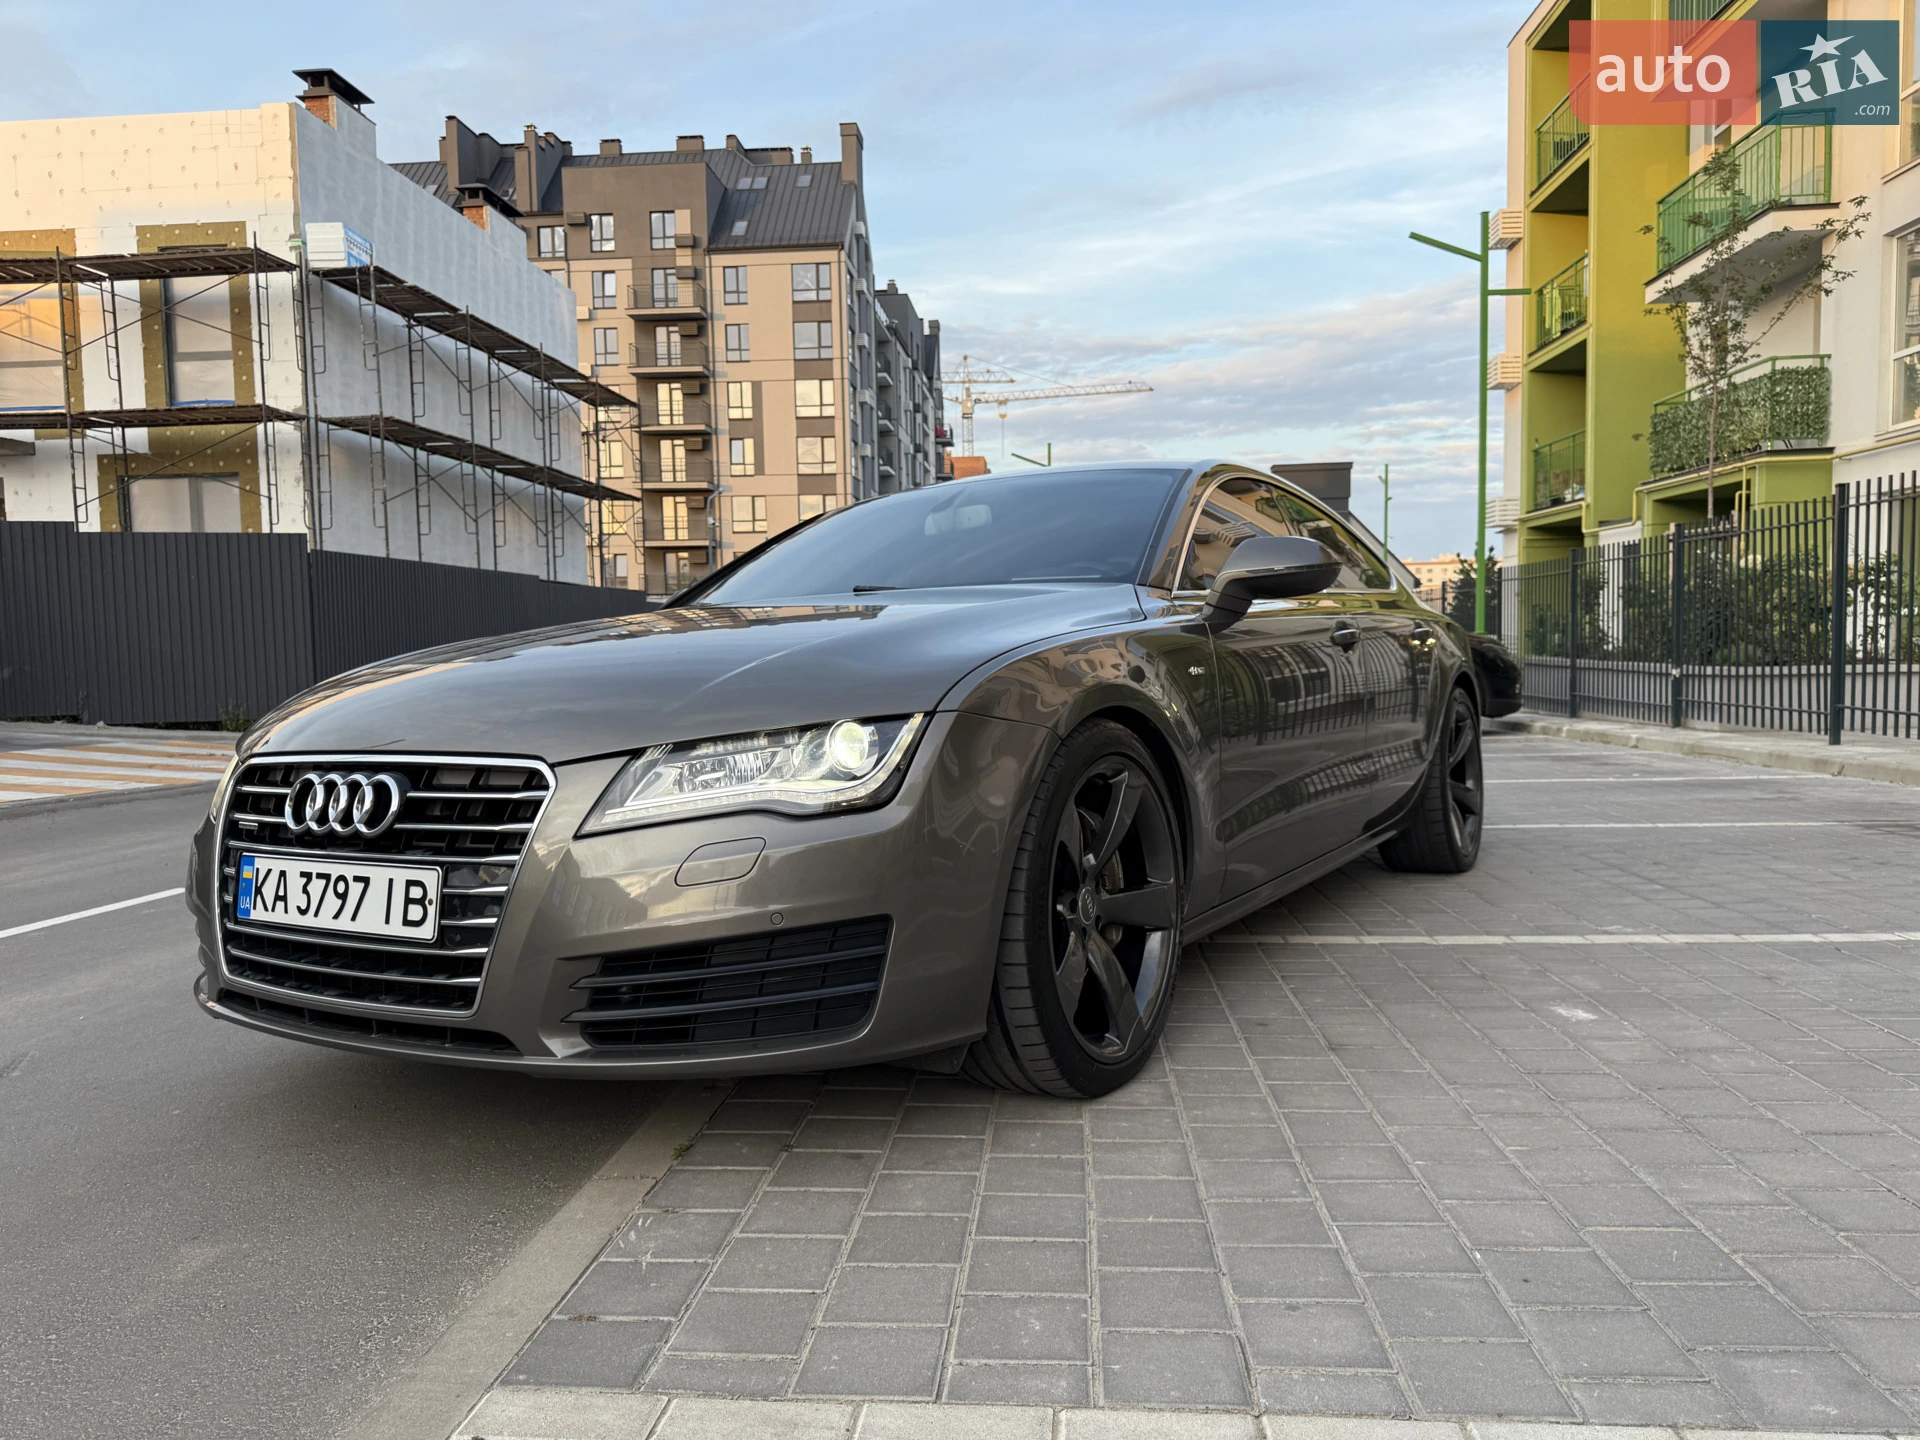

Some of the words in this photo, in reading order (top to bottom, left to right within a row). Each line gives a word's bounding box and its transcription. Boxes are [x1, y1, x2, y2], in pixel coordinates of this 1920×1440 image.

[240, 895, 250, 910] UA
[252, 867, 289, 914] KA
[296, 871, 371, 921] 3797
[384, 878, 428, 927] IB
